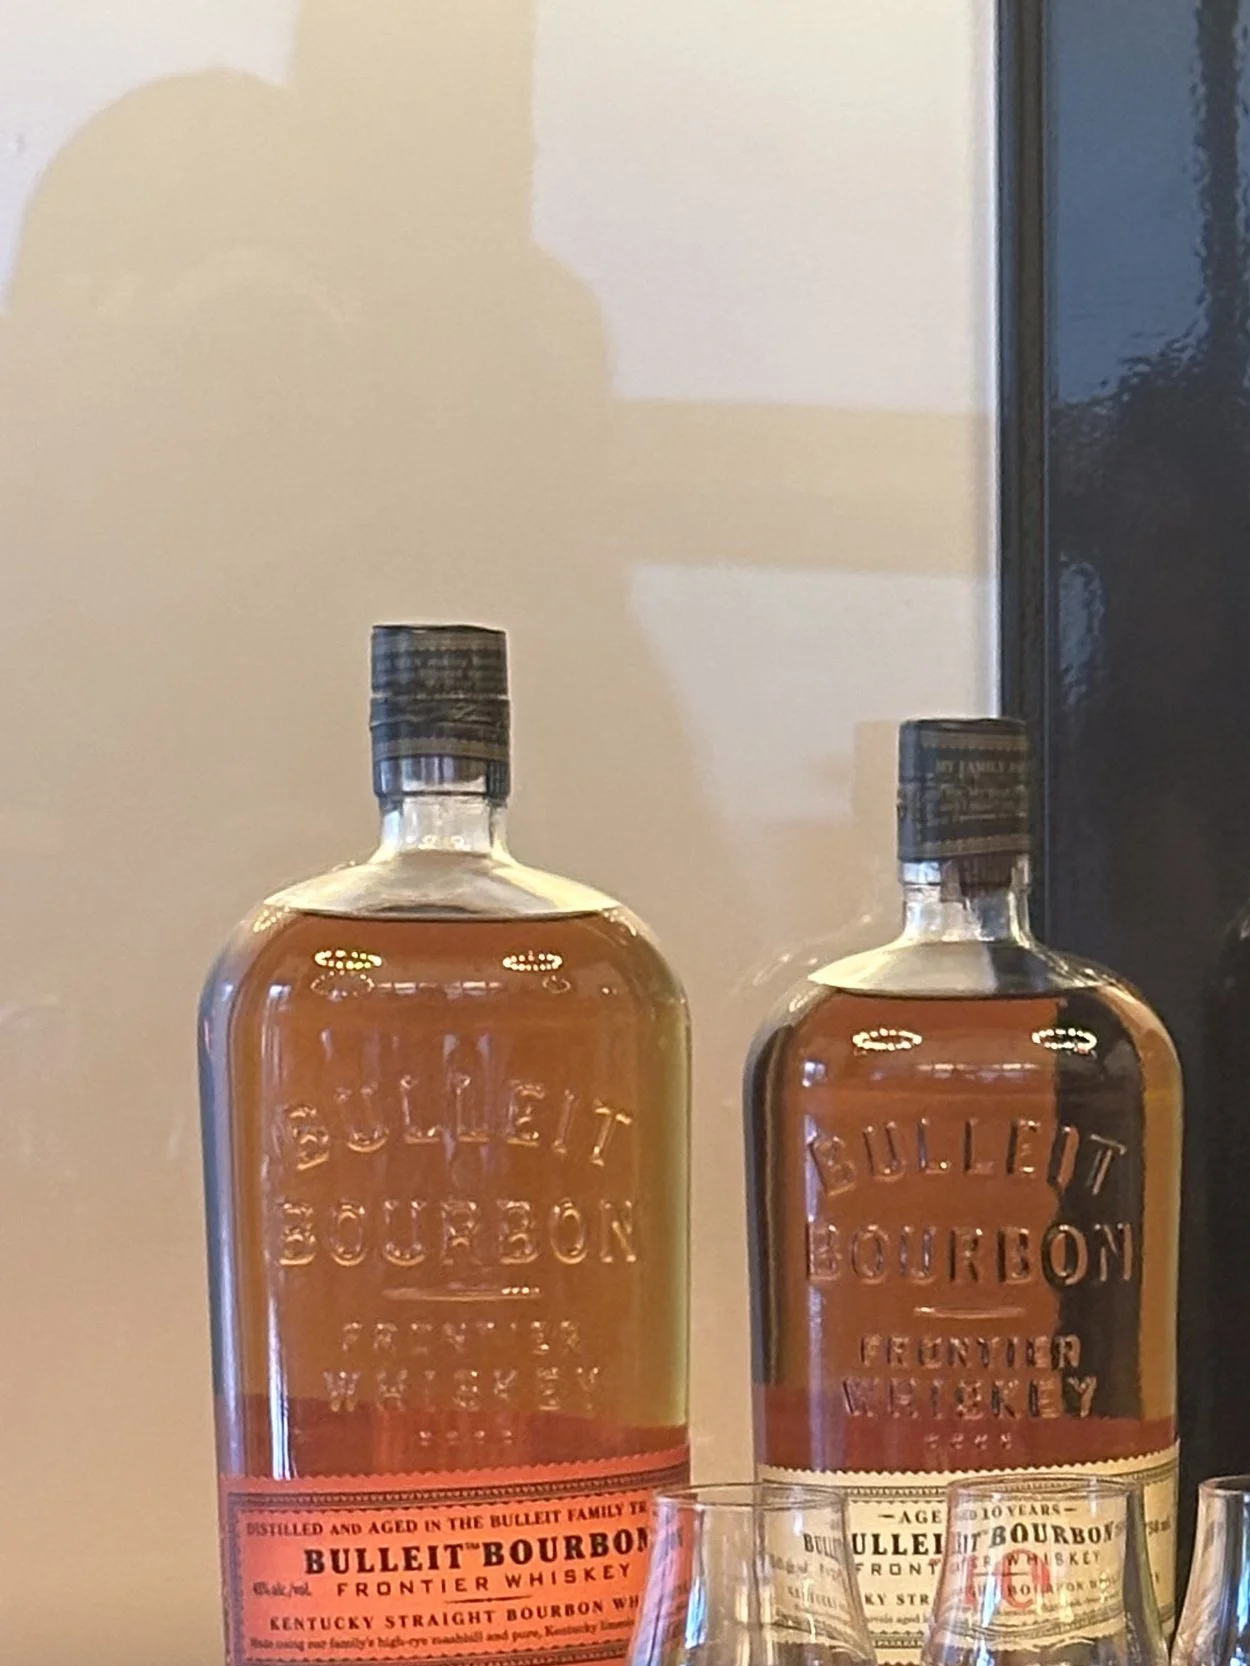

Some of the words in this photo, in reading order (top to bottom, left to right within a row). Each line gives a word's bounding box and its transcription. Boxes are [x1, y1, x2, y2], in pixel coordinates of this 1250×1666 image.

[283, 1073, 633, 1171] BULLEIT
[808, 1117, 1127, 1196] BULLEIT
[278, 1198, 638, 1267] BOURBON
[806, 1223, 1134, 1287] BOURBON
[859, 1333, 1081, 1370] FRONTIER
[324, 1367, 602, 1412] WHISKEY
[842, 1376, 1097, 1419] WHISKEY
[247, 1522, 323, 1536] DISTILLED
[330, 1523, 362, 1535] AND
[369, 1520, 418, 1534] AGED
[425, 1520, 441, 1532] IN
[449, 1516, 484, 1531] THE
[490, 1510, 562, 1529] BULLEIT
[568, 1503, 624, 1523] FAMILY
[983, 1507, 1003, 1521] 10
[1008, 1503, 1060, 1516] YEARS
[989, 1522, 1115, 1549] BOURBON
[1008, 1551, 1100, 1566] WHISKEY
[337, 1577, 489, 1597] FRONTIER
[505, 1563, 631, 1588] WHISKEY
[270, 1616, 374, 1631] KENTUCKY
[385, 1609, 496, 1629] STRAIGHT
[506, 1600, 604, 1621] BOURBON
